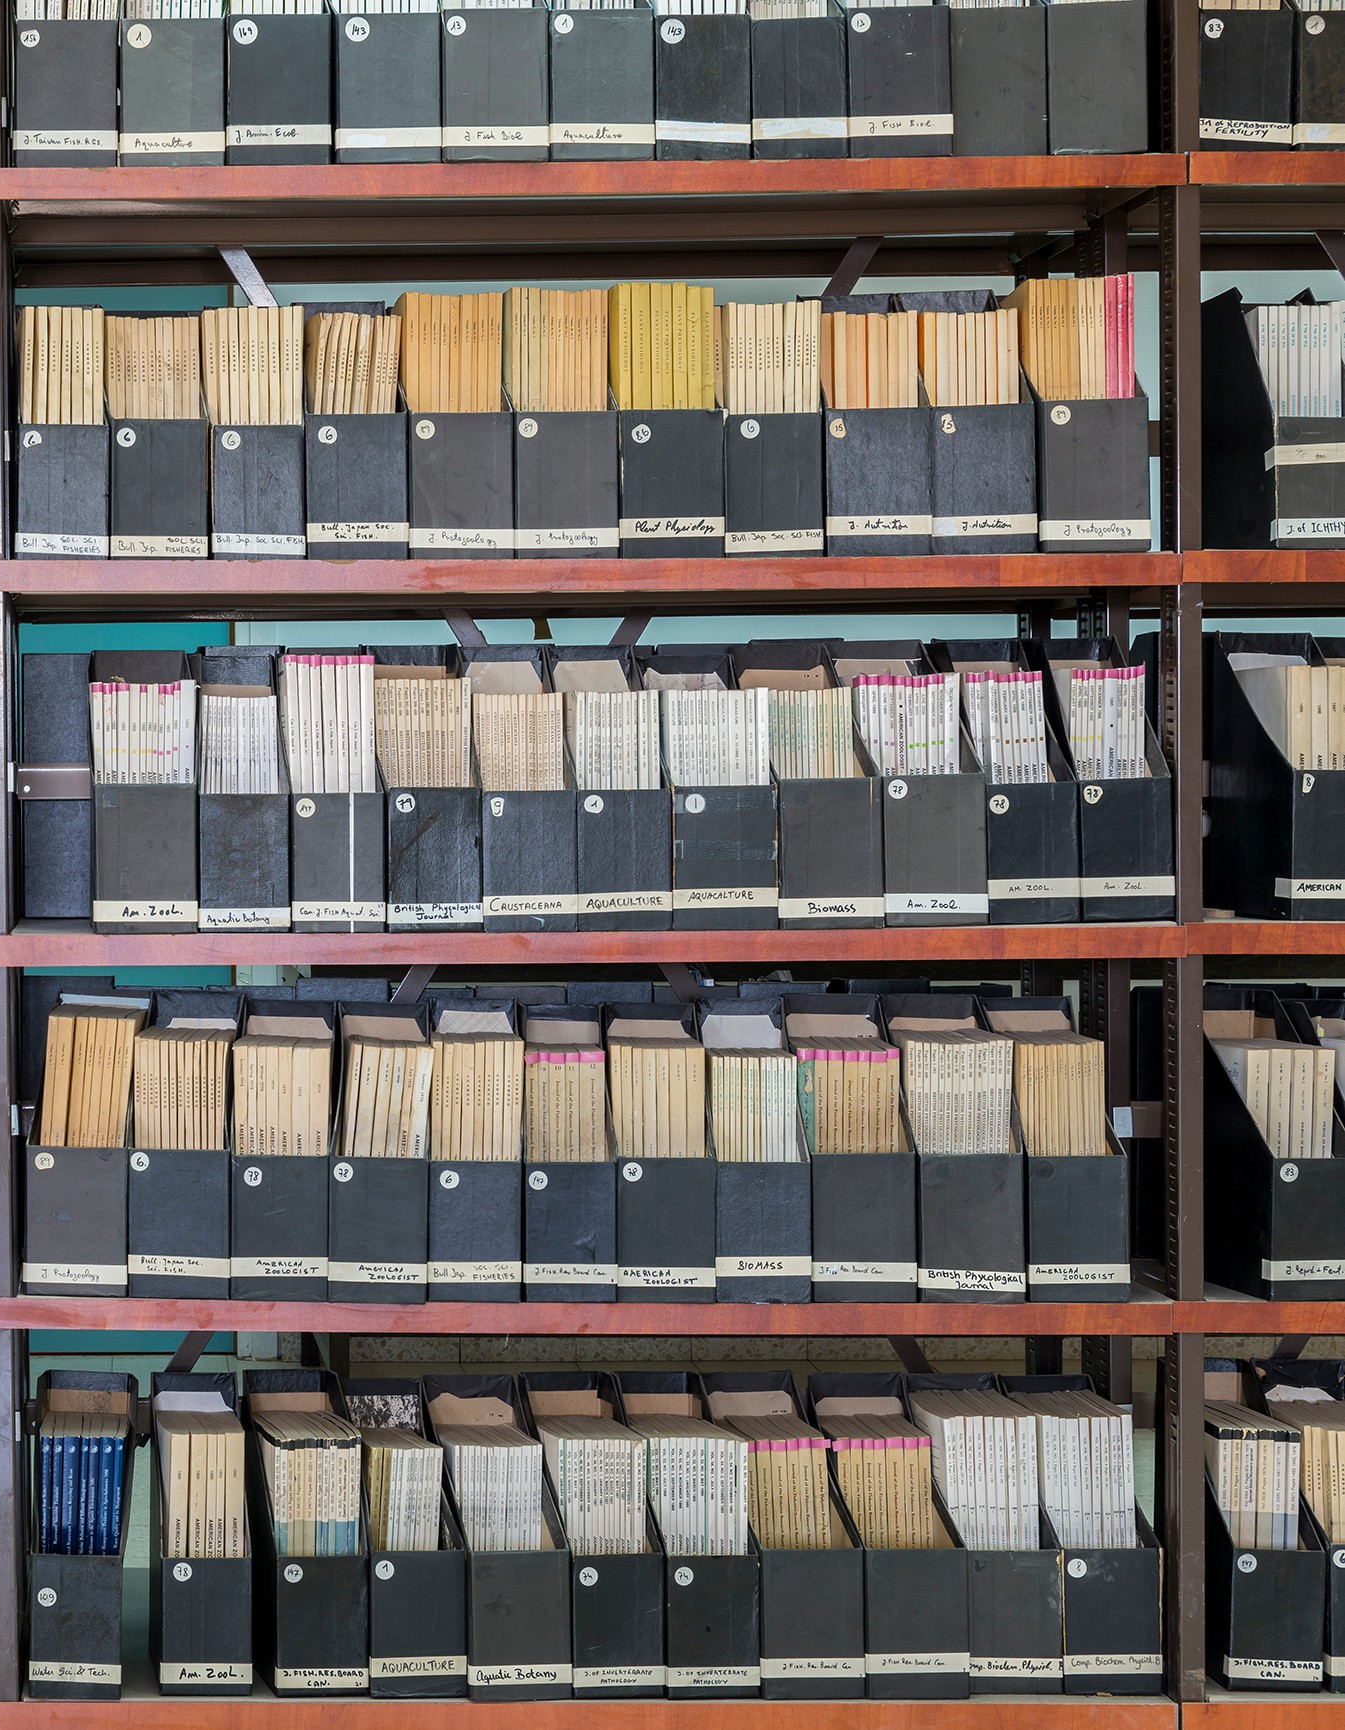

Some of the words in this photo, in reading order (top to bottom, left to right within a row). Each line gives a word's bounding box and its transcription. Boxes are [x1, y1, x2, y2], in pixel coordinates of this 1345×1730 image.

[352, 24, 366, 35] 143
[450, 21, 461, 31] 13
[667, 26, 682, 36] 143
[1208, 23, 1222, 33] 83
[239, 27, 253, 38] 169
[1227, 120, 1290, 129] REPRODUCTION
[1215, 126, 1269, 138] FERTILITY
[63, 545, 101, 553] FISHERIES
[165, 546, 201, 555] FISHERIES
[893, 785, 903, 795] 78
[398, 798, 413, 810] 79
[993, 799, 1005, 809] 78
[1296, 883, 1342, 893] AMERICAN
[586, 896, 663, 910] AQUACULTURE
[807, 902, 856, 914] Biomass
[907, 899, 927, 908] Am.
[394, 905, 427, 913] British
[247, 1170, 259, 1182] 78
[737, 1260, 783, 1271] BIOMASS
[265, 1267, 319, 1275] ZOOLOGIST
[928, 1270, 961, 1279] British
[1063, 1272, 1115, 1280] ZOOLOGIST
[473, 1272, 515, 1281] FISHERIES
[176, 1566, 188, 1577] 78
[40, 1593, 55, 1603] 109
[1071, 1658, 1092, 1669] Comp.
[179, 1668, 201, 1680] Am.
[476, 1669, 512, 1683] Aquatic
[514, 1668, 557, 1681] Botany
